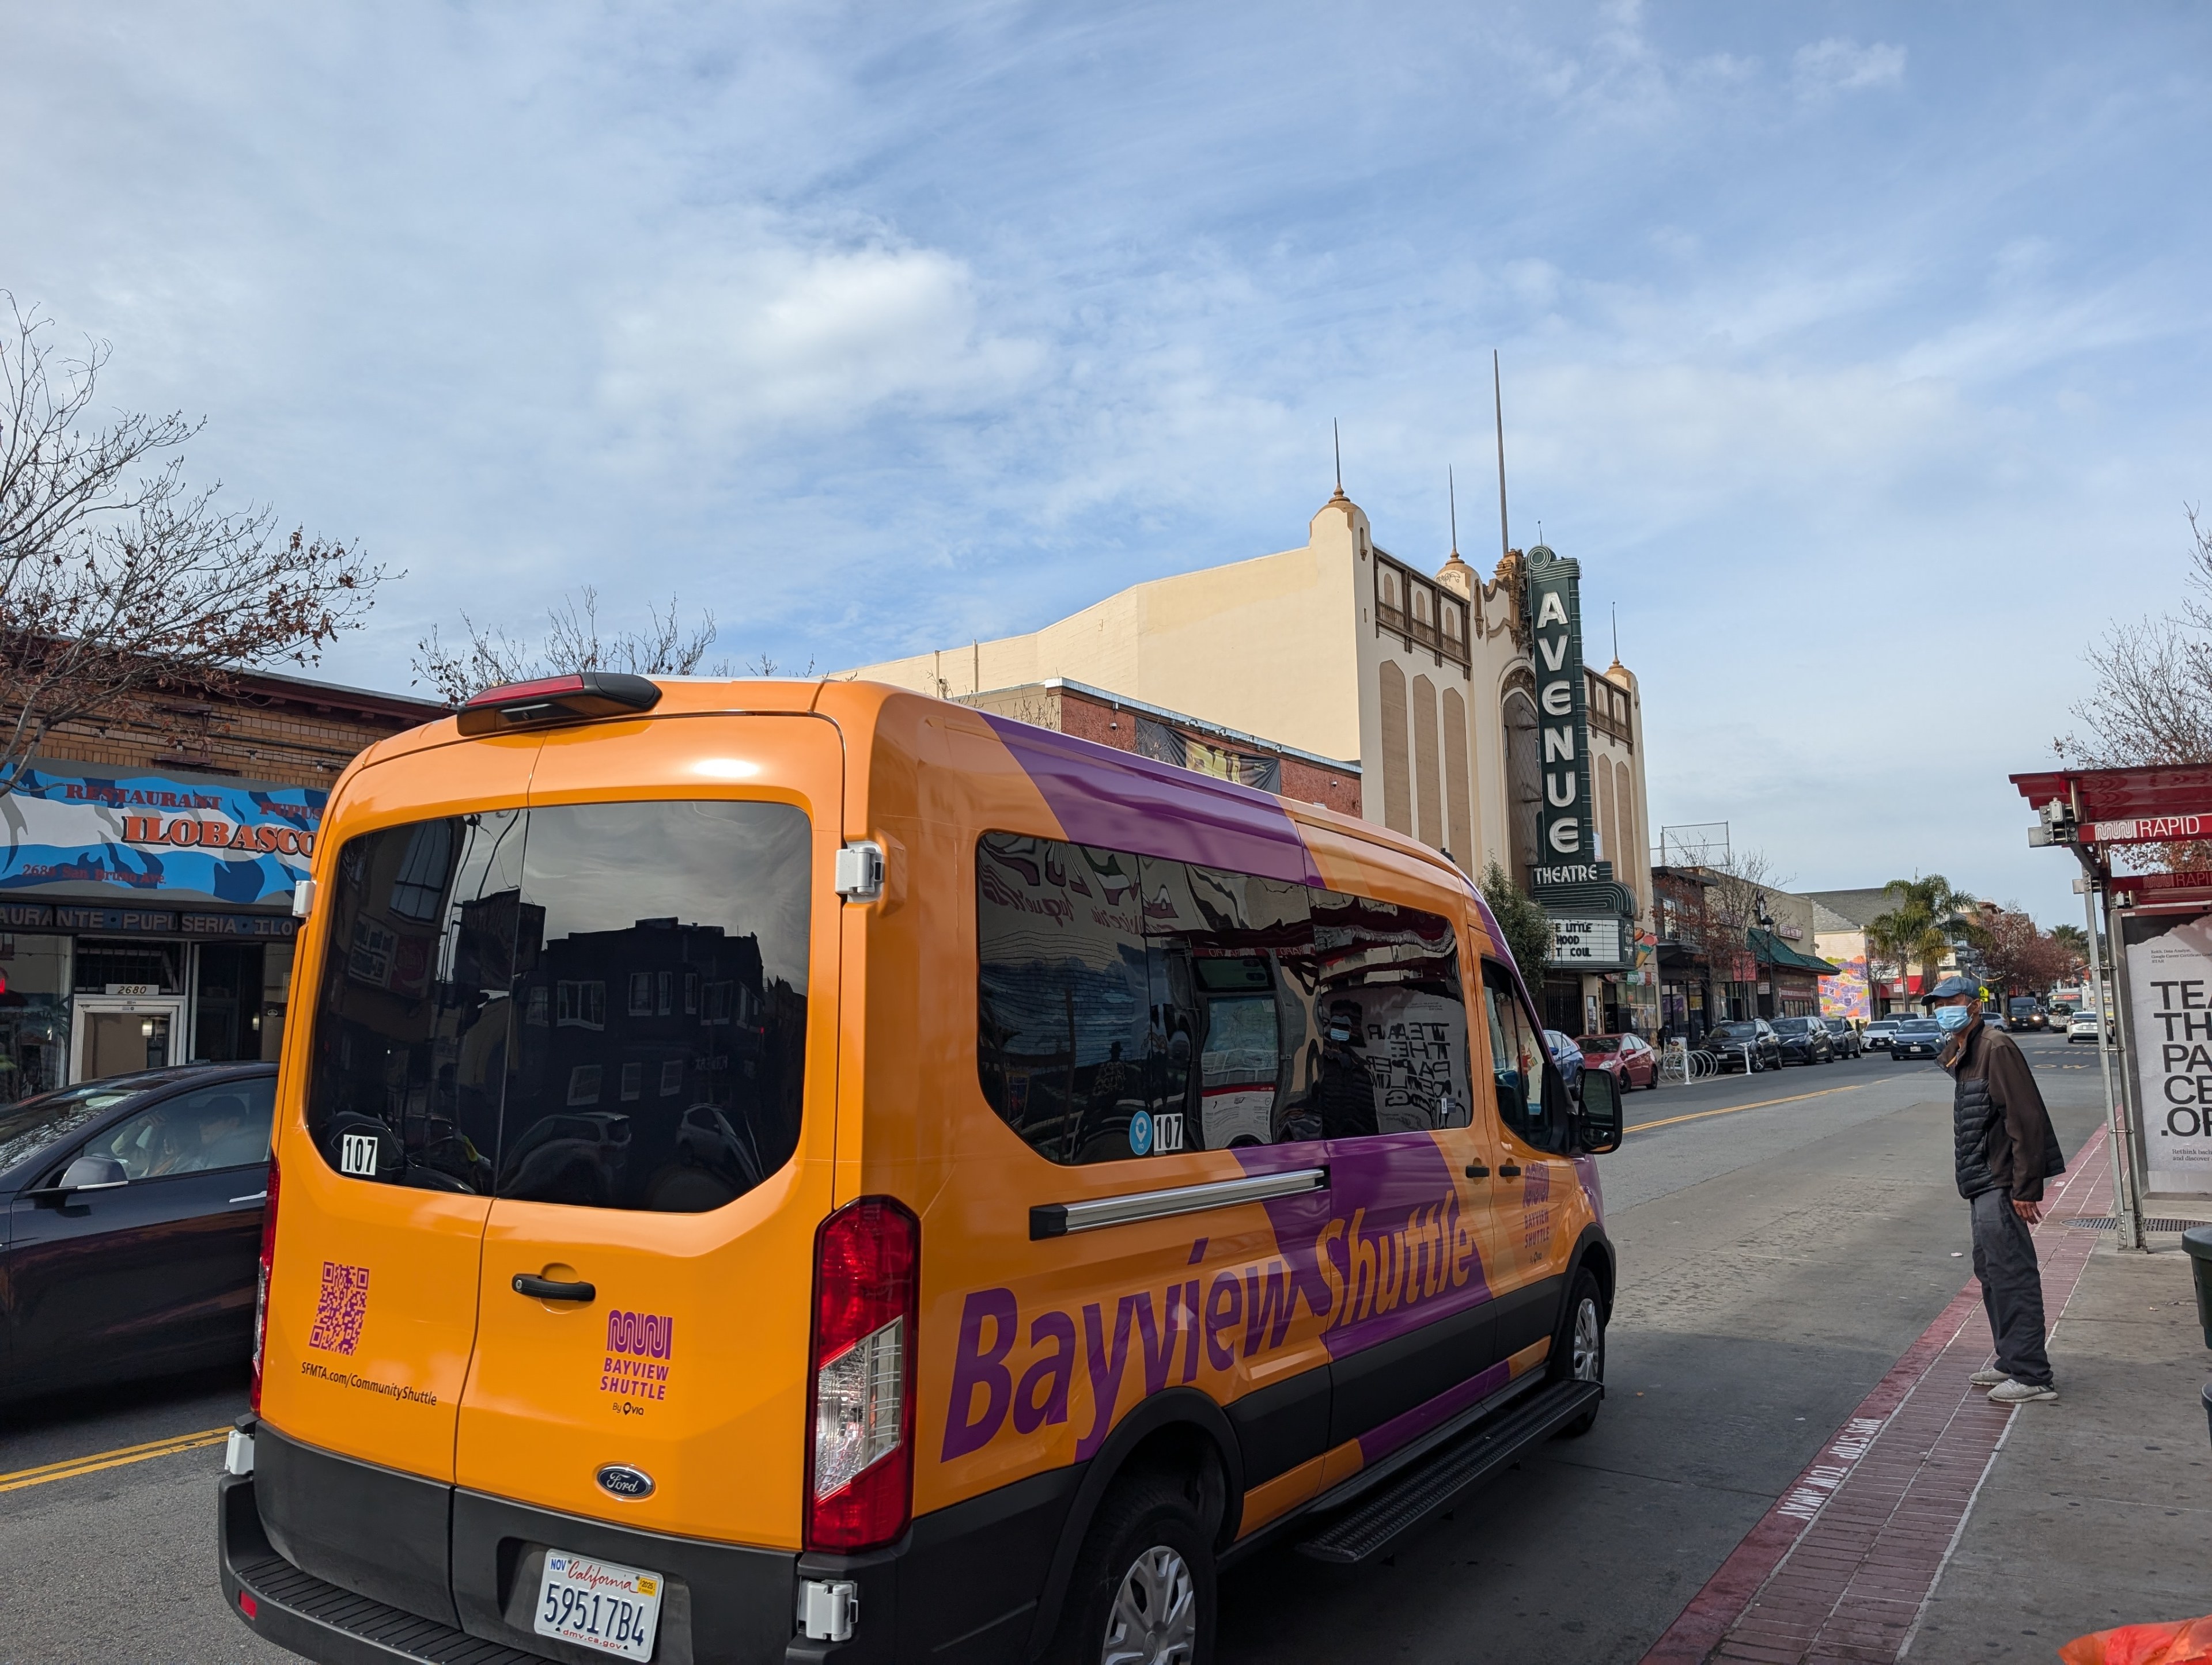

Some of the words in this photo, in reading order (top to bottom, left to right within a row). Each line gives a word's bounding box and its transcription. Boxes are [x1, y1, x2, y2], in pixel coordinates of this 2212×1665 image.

[1537, 592, 1580, 853] AVENUE
[65, 784, 222, 810] RESTAURANT
[120, 815, 317, 858] ILOBASCO
[2139, 816, 2200, 838] RAPID
[63, 866, 90, 879] San
[95, 868, 137, 882] Bruno
[140, 872, 166, 885] Ave.
[1533, 864, 1598, 885] THEATRE
[2176, 871, 2212, 888] RAPI
[123, 913, 238, 934] PUPUSERIA
[254, 919, 301, 936] ILO
[1566, 923, 1592, 933] LITTLE
[1556, 935, 1580, 945] HOOD
[118, 986, 147, 995] 2680
[2150, 980, 2212, 1010] TE
[1157, 1116, 1182, 1149] 107
[345, 1136, 376, 1173] 107
[1525, 1209, 1550, 1230] BAYVIEW
[1525, 1232, 1550, 1249] SHUTTLE
[941, 1237, 1301, 1465] Bayview
[1312, 1189, 1475, 1327] Shuttle
[603, 1357, 670, 1382] BAYVIEW
[301, 1361, 437, 1406] SFMTA.com/CommunityShuttle
[600, 1375, 667, 1401] SHUTTLE
[612, 1402, 622, 1414] By
[1844, 1418, 1884, 1435] BUS
[1828, 1435, 1870, 1459] STOP
[607, 1471, 639, 1493] Ford
[1802, 1465, 1849, 1489] TOW
[1777, 1487, 1830, 1521] AWAY
[551, 1558, 567, 1571] NOV
[568, 1560, 639, 1594] California
[544, 1583, 645, 1647] 59517B4
[563, 1629, 622, 1649] dmv.ca.gov
